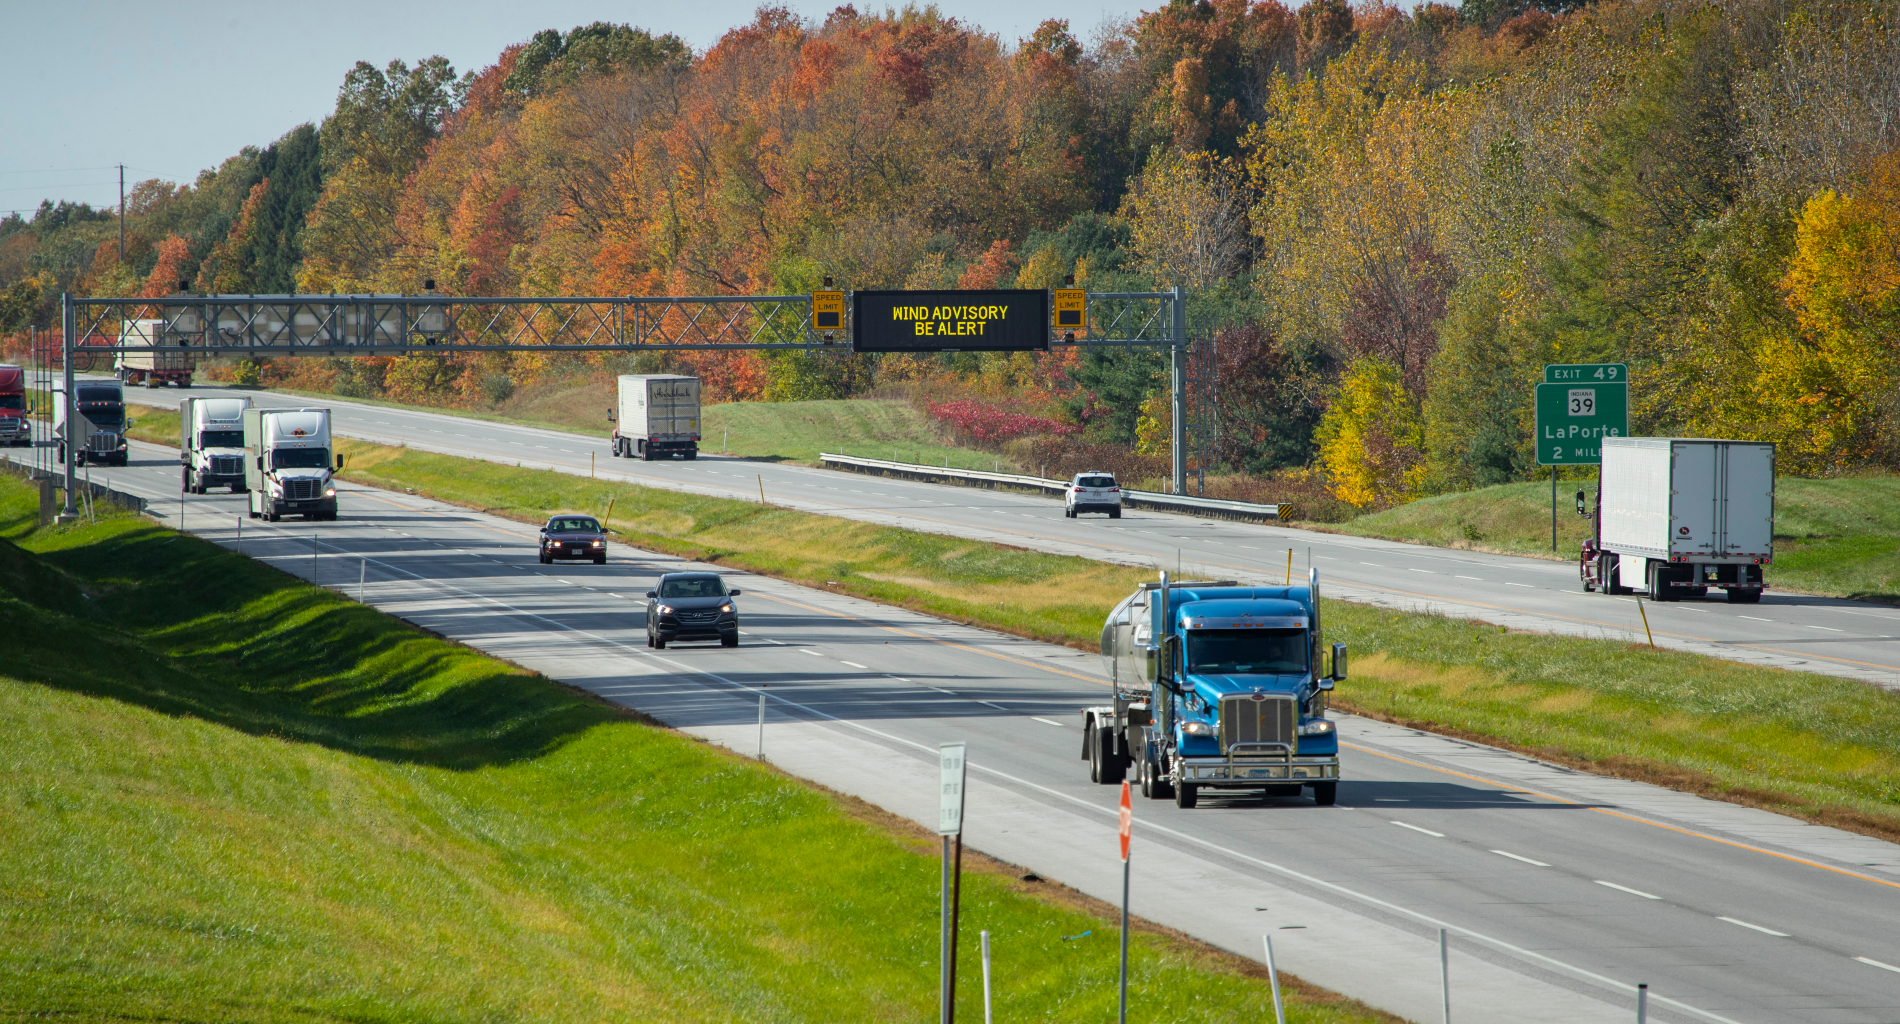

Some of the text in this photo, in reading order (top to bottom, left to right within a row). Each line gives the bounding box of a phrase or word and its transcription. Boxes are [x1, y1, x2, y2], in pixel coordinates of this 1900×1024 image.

[893, 305, 1008, 320] WIND ADVISORY
[915, 321, 986, 336] BE ALERT
[1554, 366, 1618, 380] EXIT 49
[1571, 398, 1594, 413] 39
[1545, 424, 1620, 439] LaPorte
[1552, 446, 1602, 460] 2 MILE
